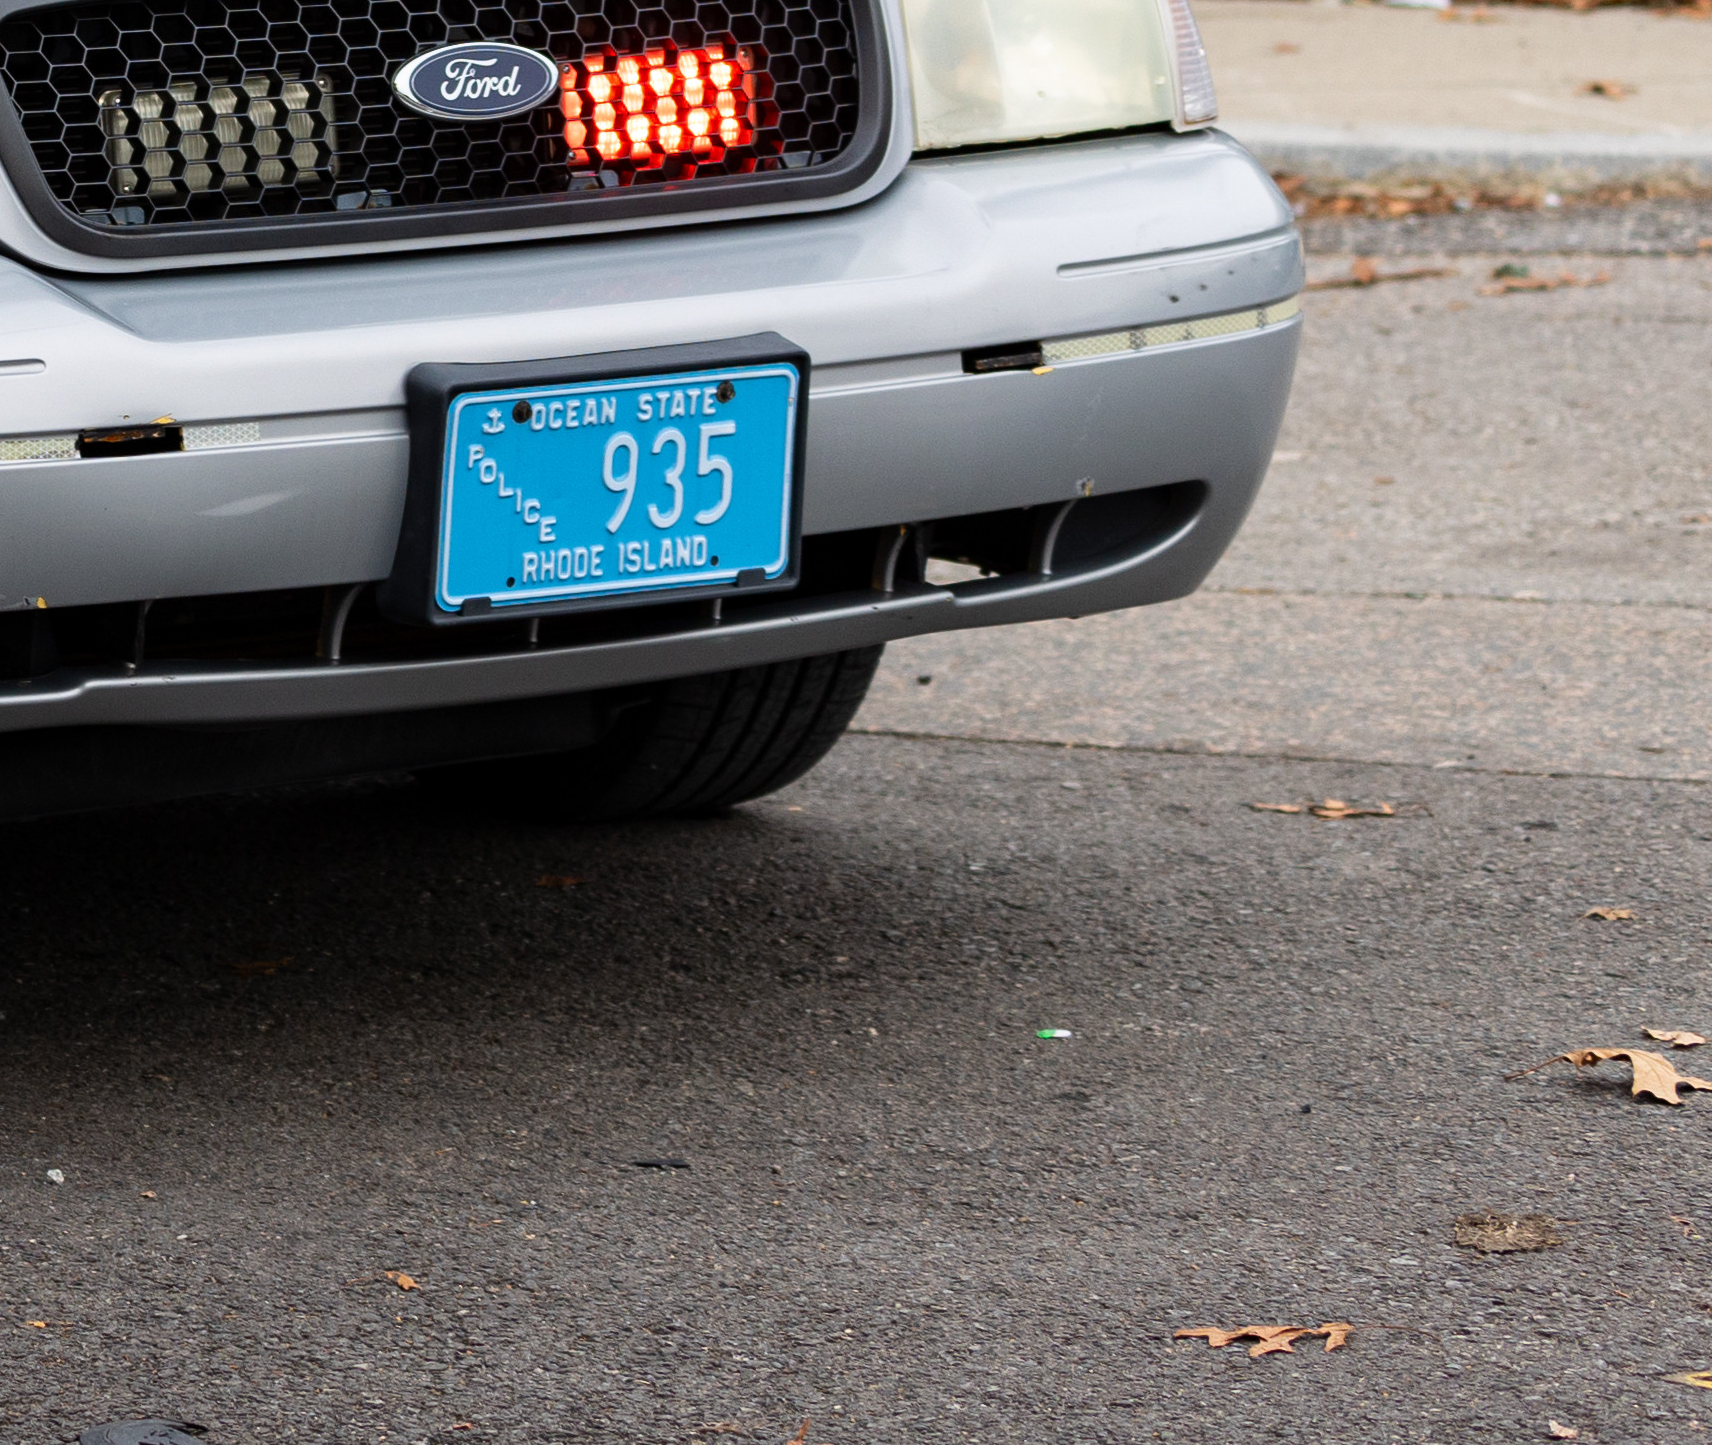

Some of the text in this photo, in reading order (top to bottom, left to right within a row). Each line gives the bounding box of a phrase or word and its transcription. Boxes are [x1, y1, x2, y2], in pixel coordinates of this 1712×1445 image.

[440, 58, 522, 101] Ford
[530, 387, 717, 431] OCEAN STATE
[467, 444, 556, 542] POLICE
[602, 420, 736, 534] 935
[522, 535, 708, 584] RHODE ISLAND
